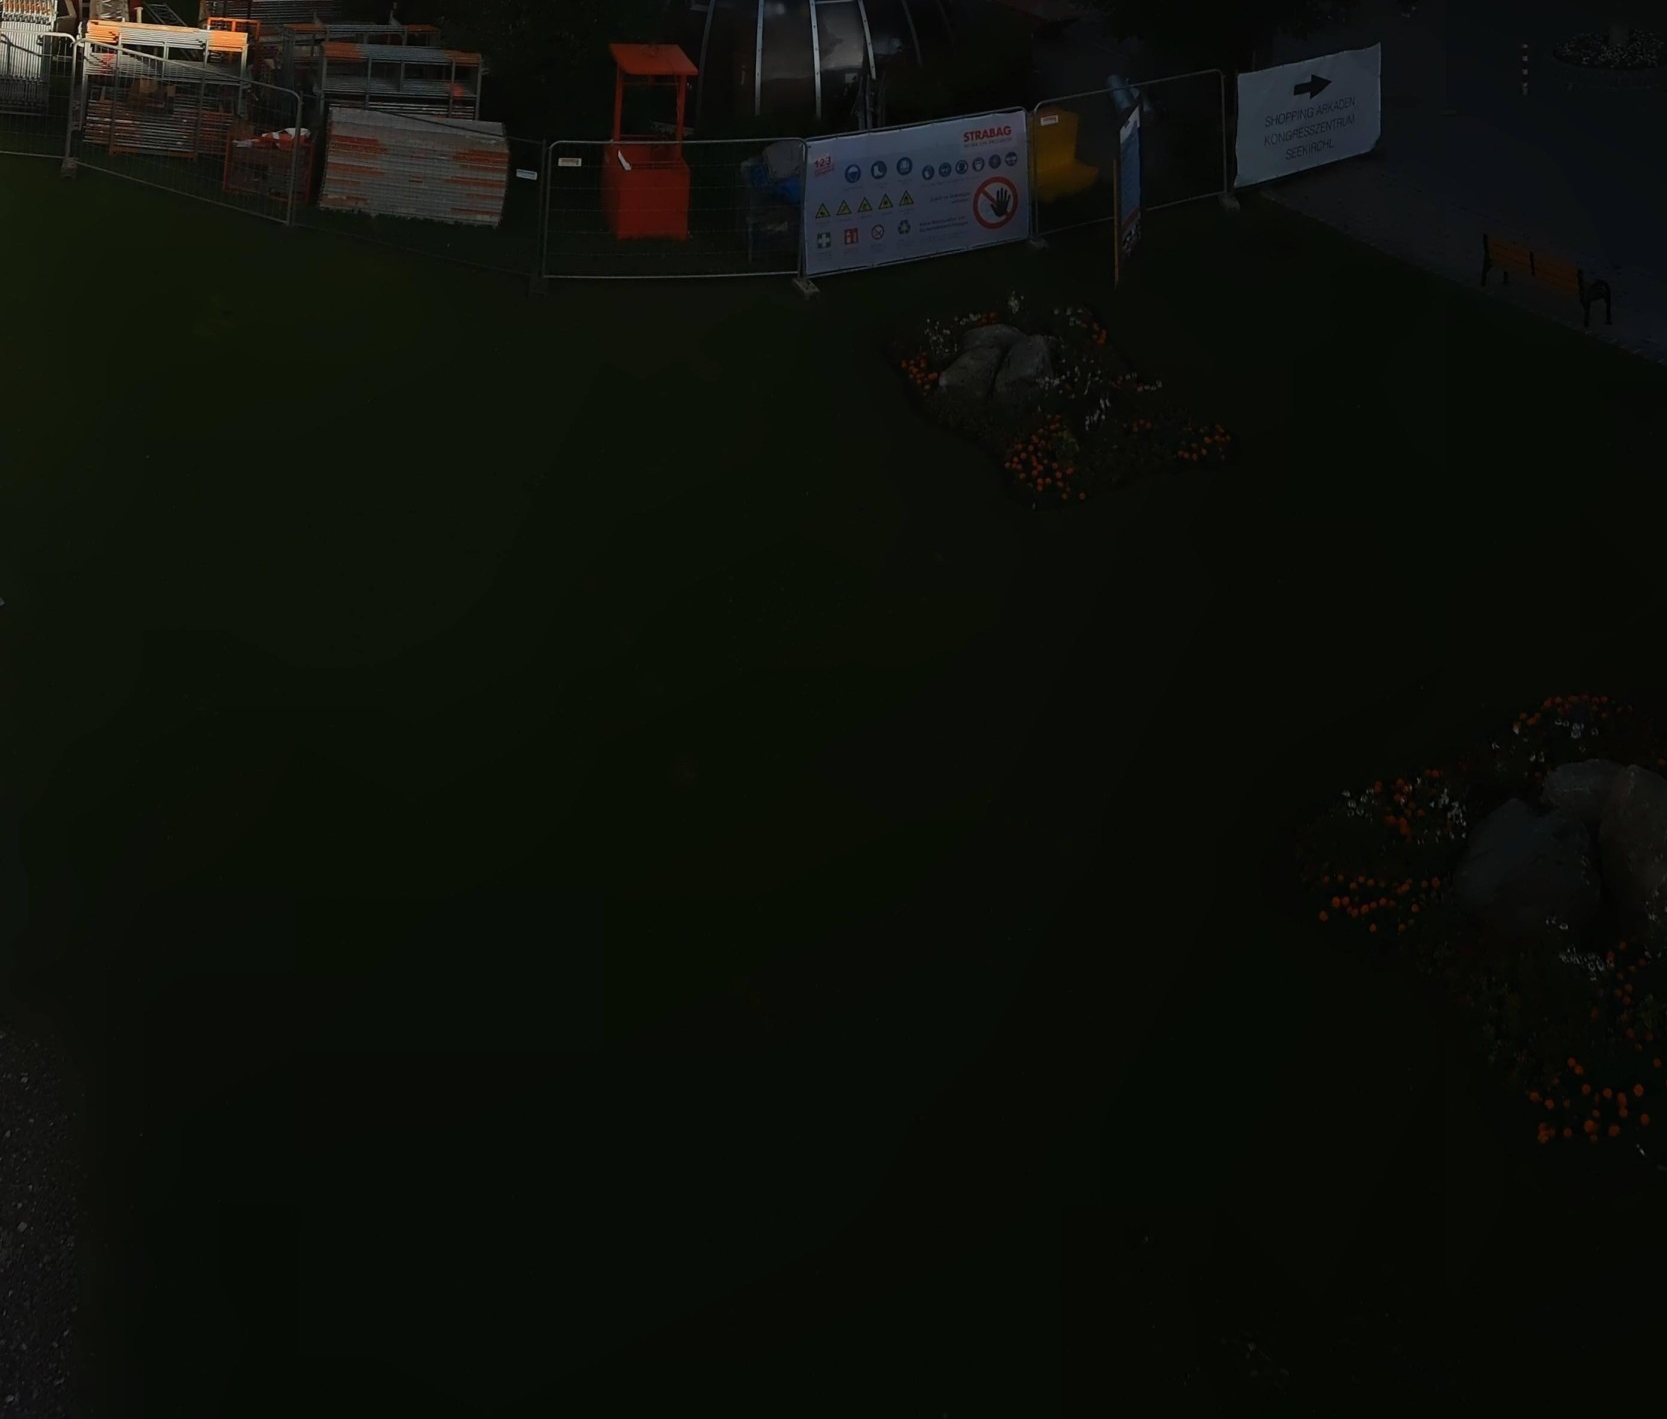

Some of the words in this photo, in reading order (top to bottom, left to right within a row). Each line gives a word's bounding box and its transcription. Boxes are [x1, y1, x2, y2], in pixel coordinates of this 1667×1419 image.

[1264, 109, 1314, 128] SHOPPING
[1315, 96, 1356, 115] ARKADEN
[963, 125, 1012, 142] STRABAG
[1264, 115, 1356, 147] KONGRESSZENTRUM
[1285, 138, 1335, 161] SEEKIRCHL
